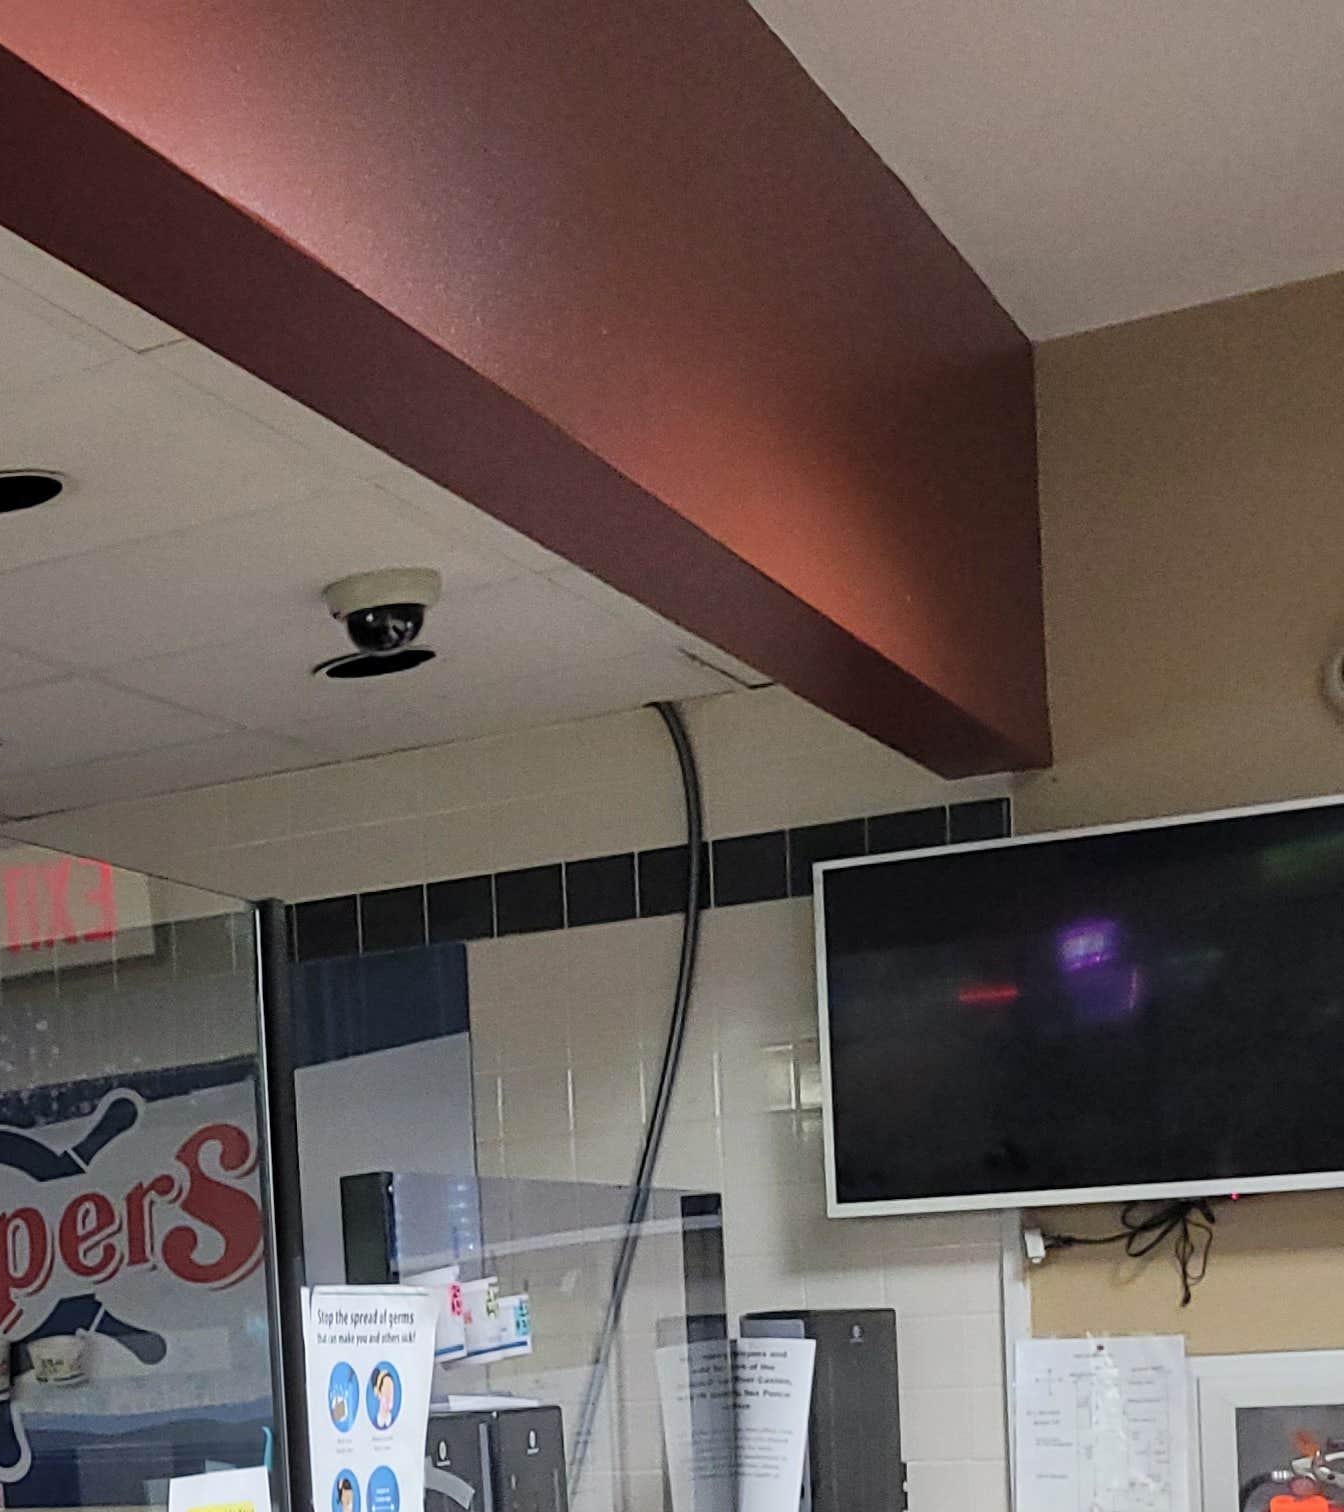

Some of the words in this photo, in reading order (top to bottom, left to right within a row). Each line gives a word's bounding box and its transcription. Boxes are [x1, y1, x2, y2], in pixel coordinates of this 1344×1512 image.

[317, 1307, 334, 1329] Stop
[335, 1307, 348, 1326] the
[350, 1307, 378, 1329] spread
[379, 1307, 388, 1325] of
[388, 1312, 415, 1329] germs
[356, 1334, 368, 1348] you
[368, 1330, 381, 1345] and
[381, 1331, 400, 1345] others
